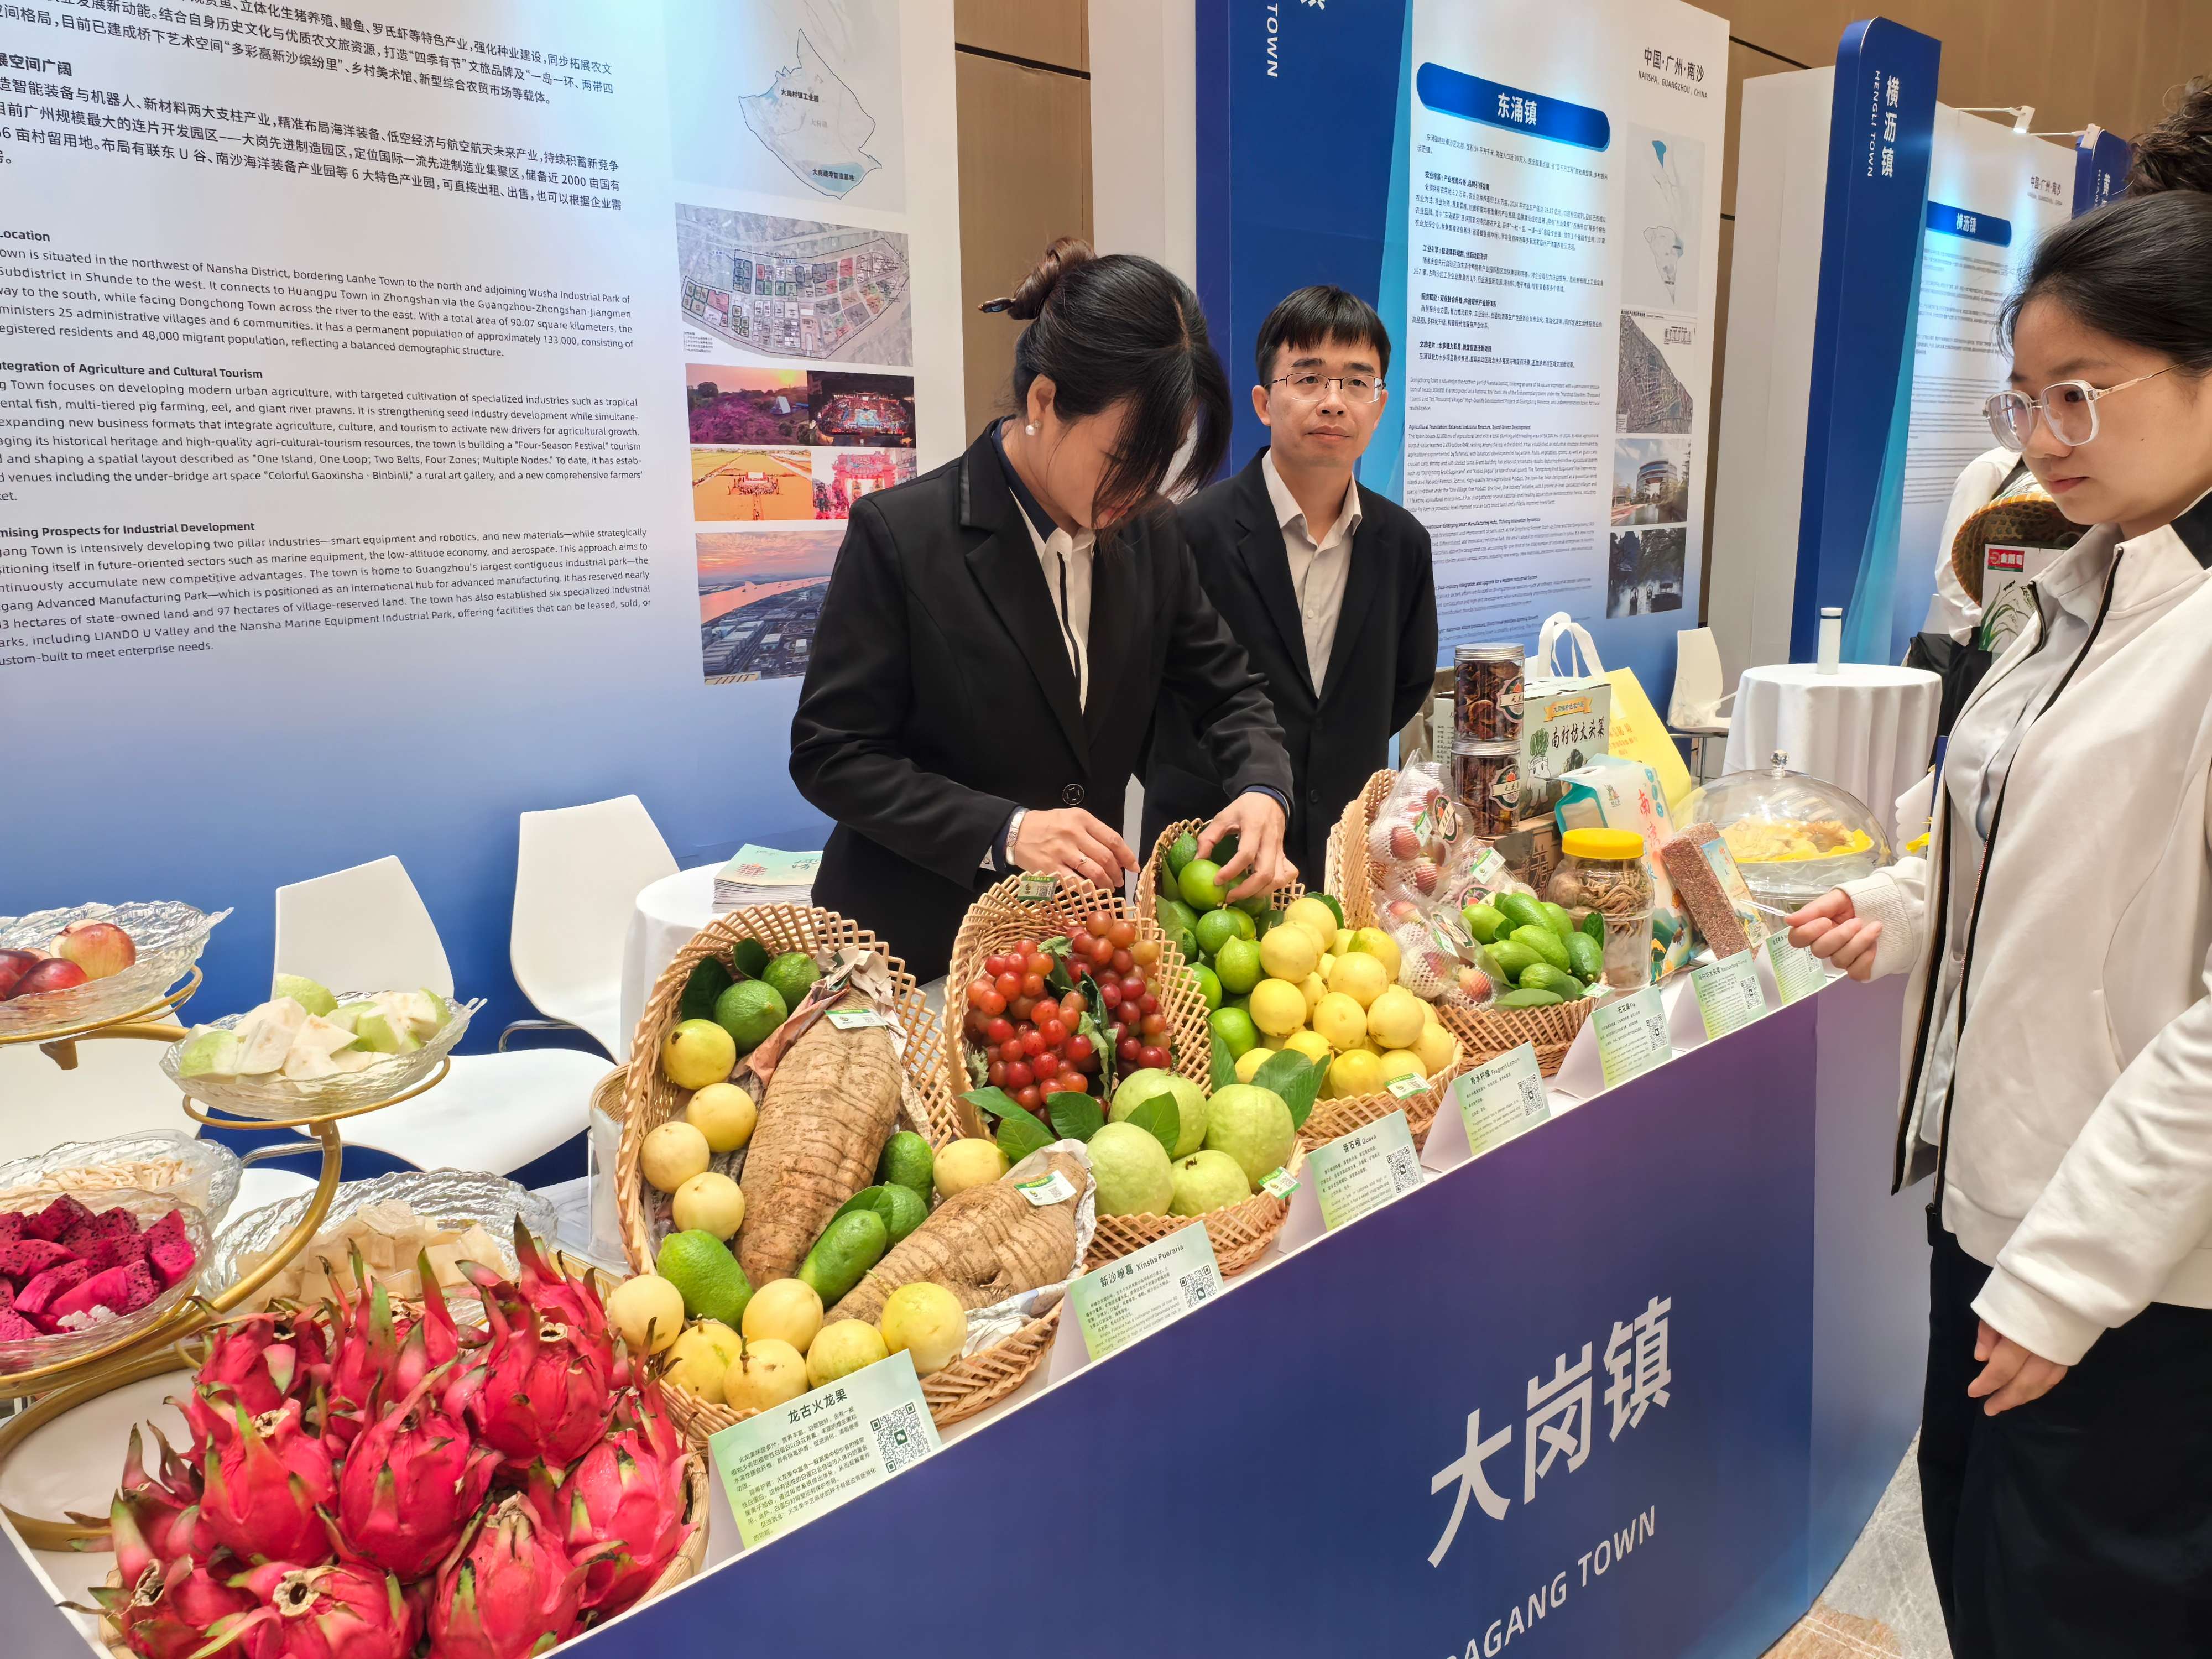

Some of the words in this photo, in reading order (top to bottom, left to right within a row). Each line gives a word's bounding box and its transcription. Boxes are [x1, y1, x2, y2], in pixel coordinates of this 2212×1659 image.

[1267, 3, 1278, 77] TOWN
[1644, 46, 1704, 83] 中国·广州·南沙
[1498, 92, 1537, 126] 东涌镇
[1694, 88, 1708, 99] CHINA
[1871, 70, 1881, 126] HENGLI
[1881, 75, 1900, 178] 横沥镇
[0, 127, 11, 139] 6
[179, 148, 189, 160] U
[194, 149, 348, 180] 谷、南沙海洋装备产业园等
[352, 168, 359, 180] 6
[1867, 132, 1876, 177] TOWN
[561, 174, 586, 187] 2000
[589, 178, 620, 192] 亩国有
[0, 229, 51, 242] ocation
[0, 249, 26, 259] own
[29, 249, 39, 260] is
[43, 251, 92, 264] situated
[95, 254, 106, 265] in
[109, 255, 128, 267] the
[131, 258, 190, 271] northwest
[192, 262, 204, 272] of
[206, 263, 248, 275] Nansha
[251, 267, 290, 279] District,
[293, 269, 343, 284] bordering
[346, 274, 377, 284] Lanhe
[378, 276, 405, 286] Town
[406, 278, 417, 288] to
[419, 279, 434, 289] the
[437, 281, 462, 291] north
[464, 284, 482, 293] and
[484, 285, 527, 298] adjoining
[529, 288, 558, 299] Wusha
[560, 290, 601, 301] Industrial
[602, 294, 620, 303] Park
[622, 295, 630, 304] of
[70, 270, 82, 281] in
[85, 272, 133, 285] Shunde
[135, 276, 148, 286] to
[152, 276, 171, 288] the
[174, 280, 206, 290] west.
[209, 281, 217, 291] It
[221, 283, 270, 294] connects
[273, 286, 285, 295] to
[288, 286, 338, 299] Huangpu
[339, 290, 368, 300] Town
[371, 291, 380, 301] in
[383, 292, 440, 305] Zhongshan
[442, 298, 457, 306] via
[459, 298, 475, 308] the
[478, 300, 631, 319] Guangzhou-Zhongshan-Jiangmen
[62, 362, 76, 373] of
[78, 363, 145, 375] Agriculture
[148, 366, 170, 376] and
[173, 366, 218, 377] Cultural
[218, 368, 263, 379] Tourism
[9, 379, 44, 390] Town
[47, 380, 96, 392] focuses
[99, 384, 114, 392] on
[118, 382, 184, 396] developing
[188, 384, 232, 395] modern
[235, 385, 268, 396] urban
[271, 387, 332, 399] agriculture,
[335, 389, 358, 399] with
[360, 390, 404, 401] targeted
[406, 391, 457, 401] cultivation
[459, 393, 469, 402] of
[471, 394, 523, 404] specialized
[526, 395, 570, 405] industries
[571, 397, 592, 405] such
[606, 398, 638, 408] tropical
[41, 526, 101, 538] Prospects
[102, 525, 120, 535] for
[123, 523, 179, 534] Industrial
[180, 522, 255, 534] Development
[0, 580, 64, 593] ntinuously
[67, 578, 138, 589] accumulate
[142, 577, 166, 586] new
[169, 573, 236, 586] competitive
[239, 571, 306, 581] advantages.
[309, 569, 329, 578] The
[332, 569, 358, 577] town
[361, 567, 369, 576] is
[372, 566, 400, 576] home
[403, 566, 413, 575] to
[415, 562, 477, 575] Guangzhou's
[480, 562, 512, 572] largest
[514, 560, 563, 571] contiguous
[566, 557, 607, 567] industrial
[1362, 1134, 1377, 1144] Guava
[1099, 1263, 1134, 1288] 新沙粉葛
[1136, 1256, 1159, 1272] Xinsha
[1158, 1244, 1184, 1260] Pueraria
[787, 1388, 848, 1424] 龙古火龙果
[1427, 1296, 1671, 1568] 大岗镇
[1446, 1571, 1566, 1659] AGANG
[1578, 1505, 1655, 1587] TOWN
